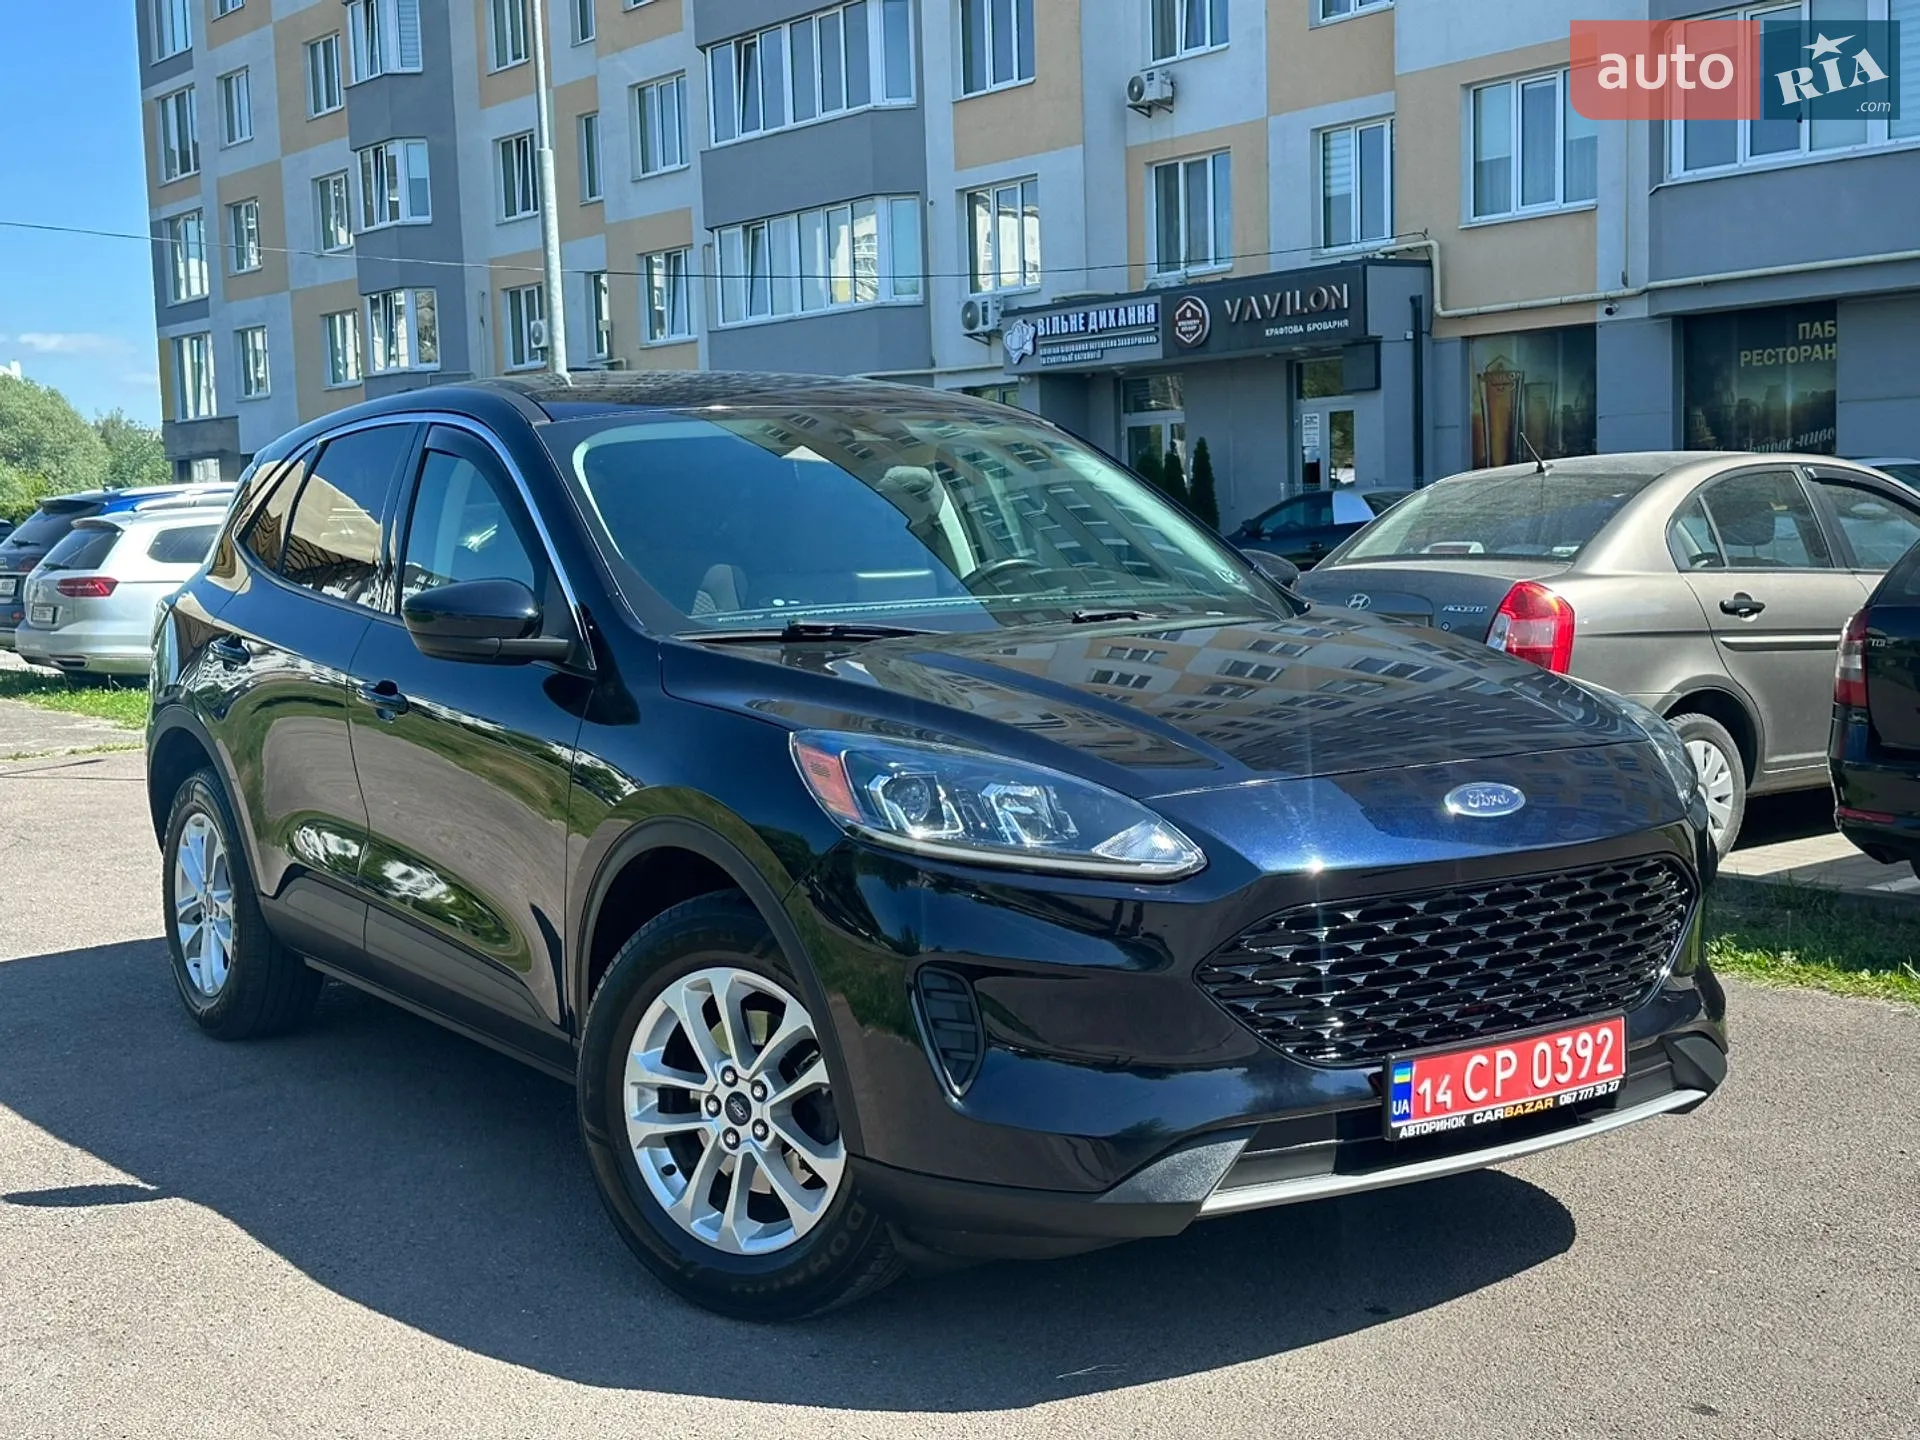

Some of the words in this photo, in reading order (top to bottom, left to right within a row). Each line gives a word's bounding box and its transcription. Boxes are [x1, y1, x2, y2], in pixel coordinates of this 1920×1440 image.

[1224, 283, 1349, 322] VAVILON
[1037, 312, 1086, 336] ВІЛЬНЕ
[1087, 303, 1157, 333] ДИХАННЯ
[1264, 324, 1304, 337] КРАФТОВА
[1306, 319, 1349, 333] БРОВАРНЯ
[1797, 320, 1836, 340] ПАБ
[1739, 342, 1836, 368] РЕСТОРАН
[1416, 1074, 1452, 1113] 14
[1463, 1049, 1518, 1102] CP
[1531, 1026, 1615, 1089] 0392
[1392, 1101, 1410, 1116] UA
[1399, 1114, 1467, 1139] АВТОРИНОК
